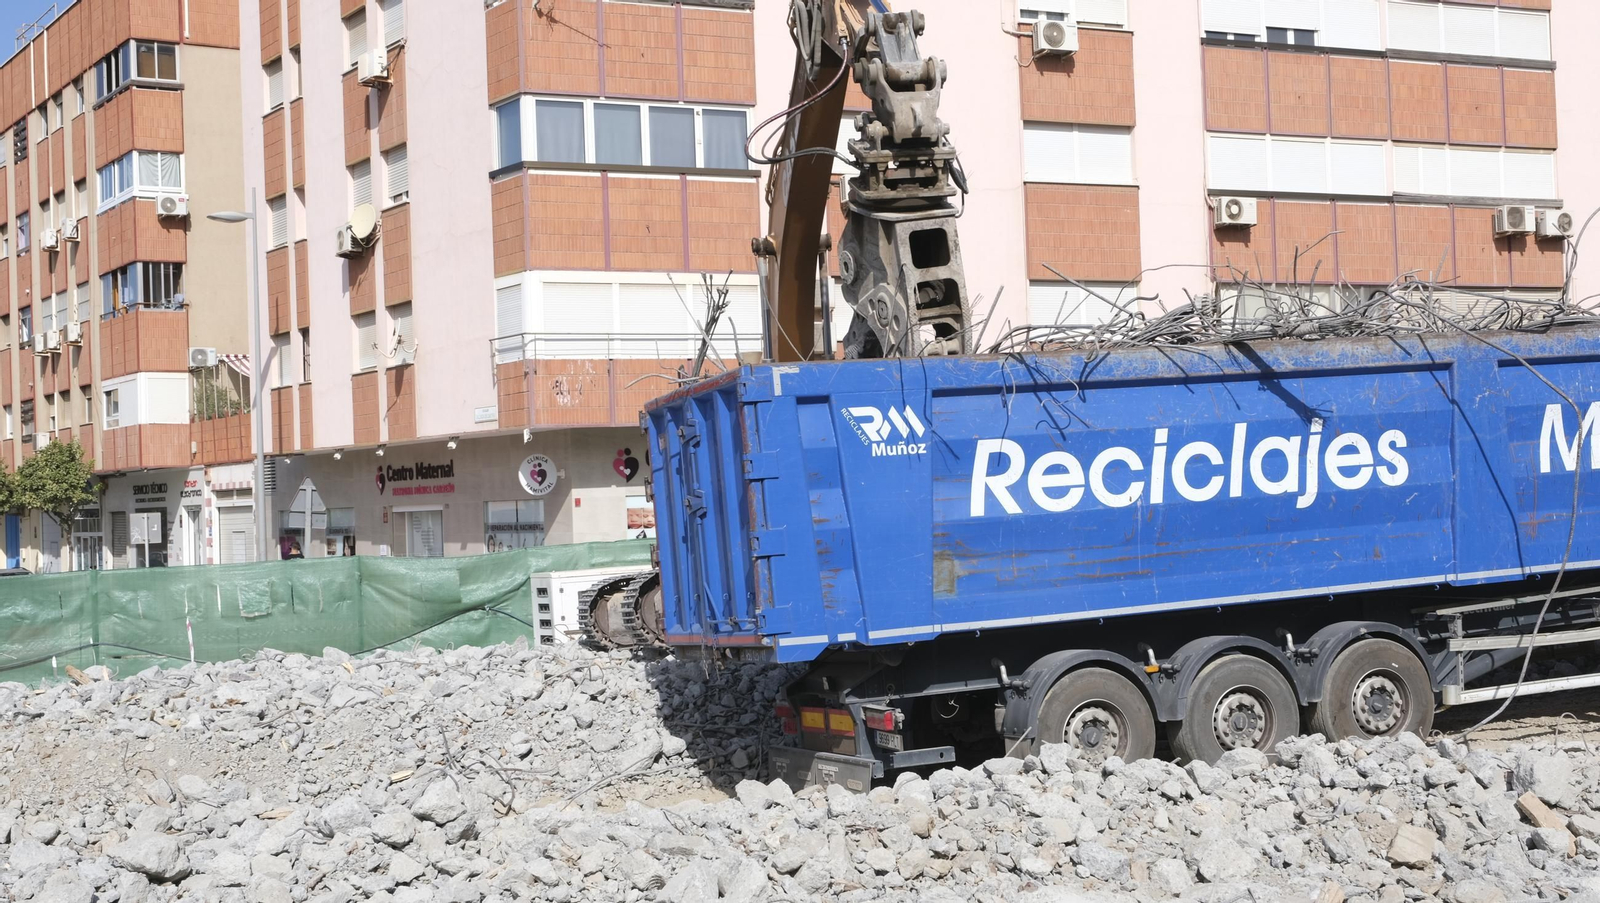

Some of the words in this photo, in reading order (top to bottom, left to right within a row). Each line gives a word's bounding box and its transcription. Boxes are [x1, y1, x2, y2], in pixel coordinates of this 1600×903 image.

[840, 407, 870, 446] RECICLAJES
[526, 455, 548, 465] CLÍNICA
[871, 440, 927, 457] Muñoz
[386, 464, 414, 482] Centro
[415, 459, 455, 480] Maternal
[969, 417, 1410, 517] Reciclajes
